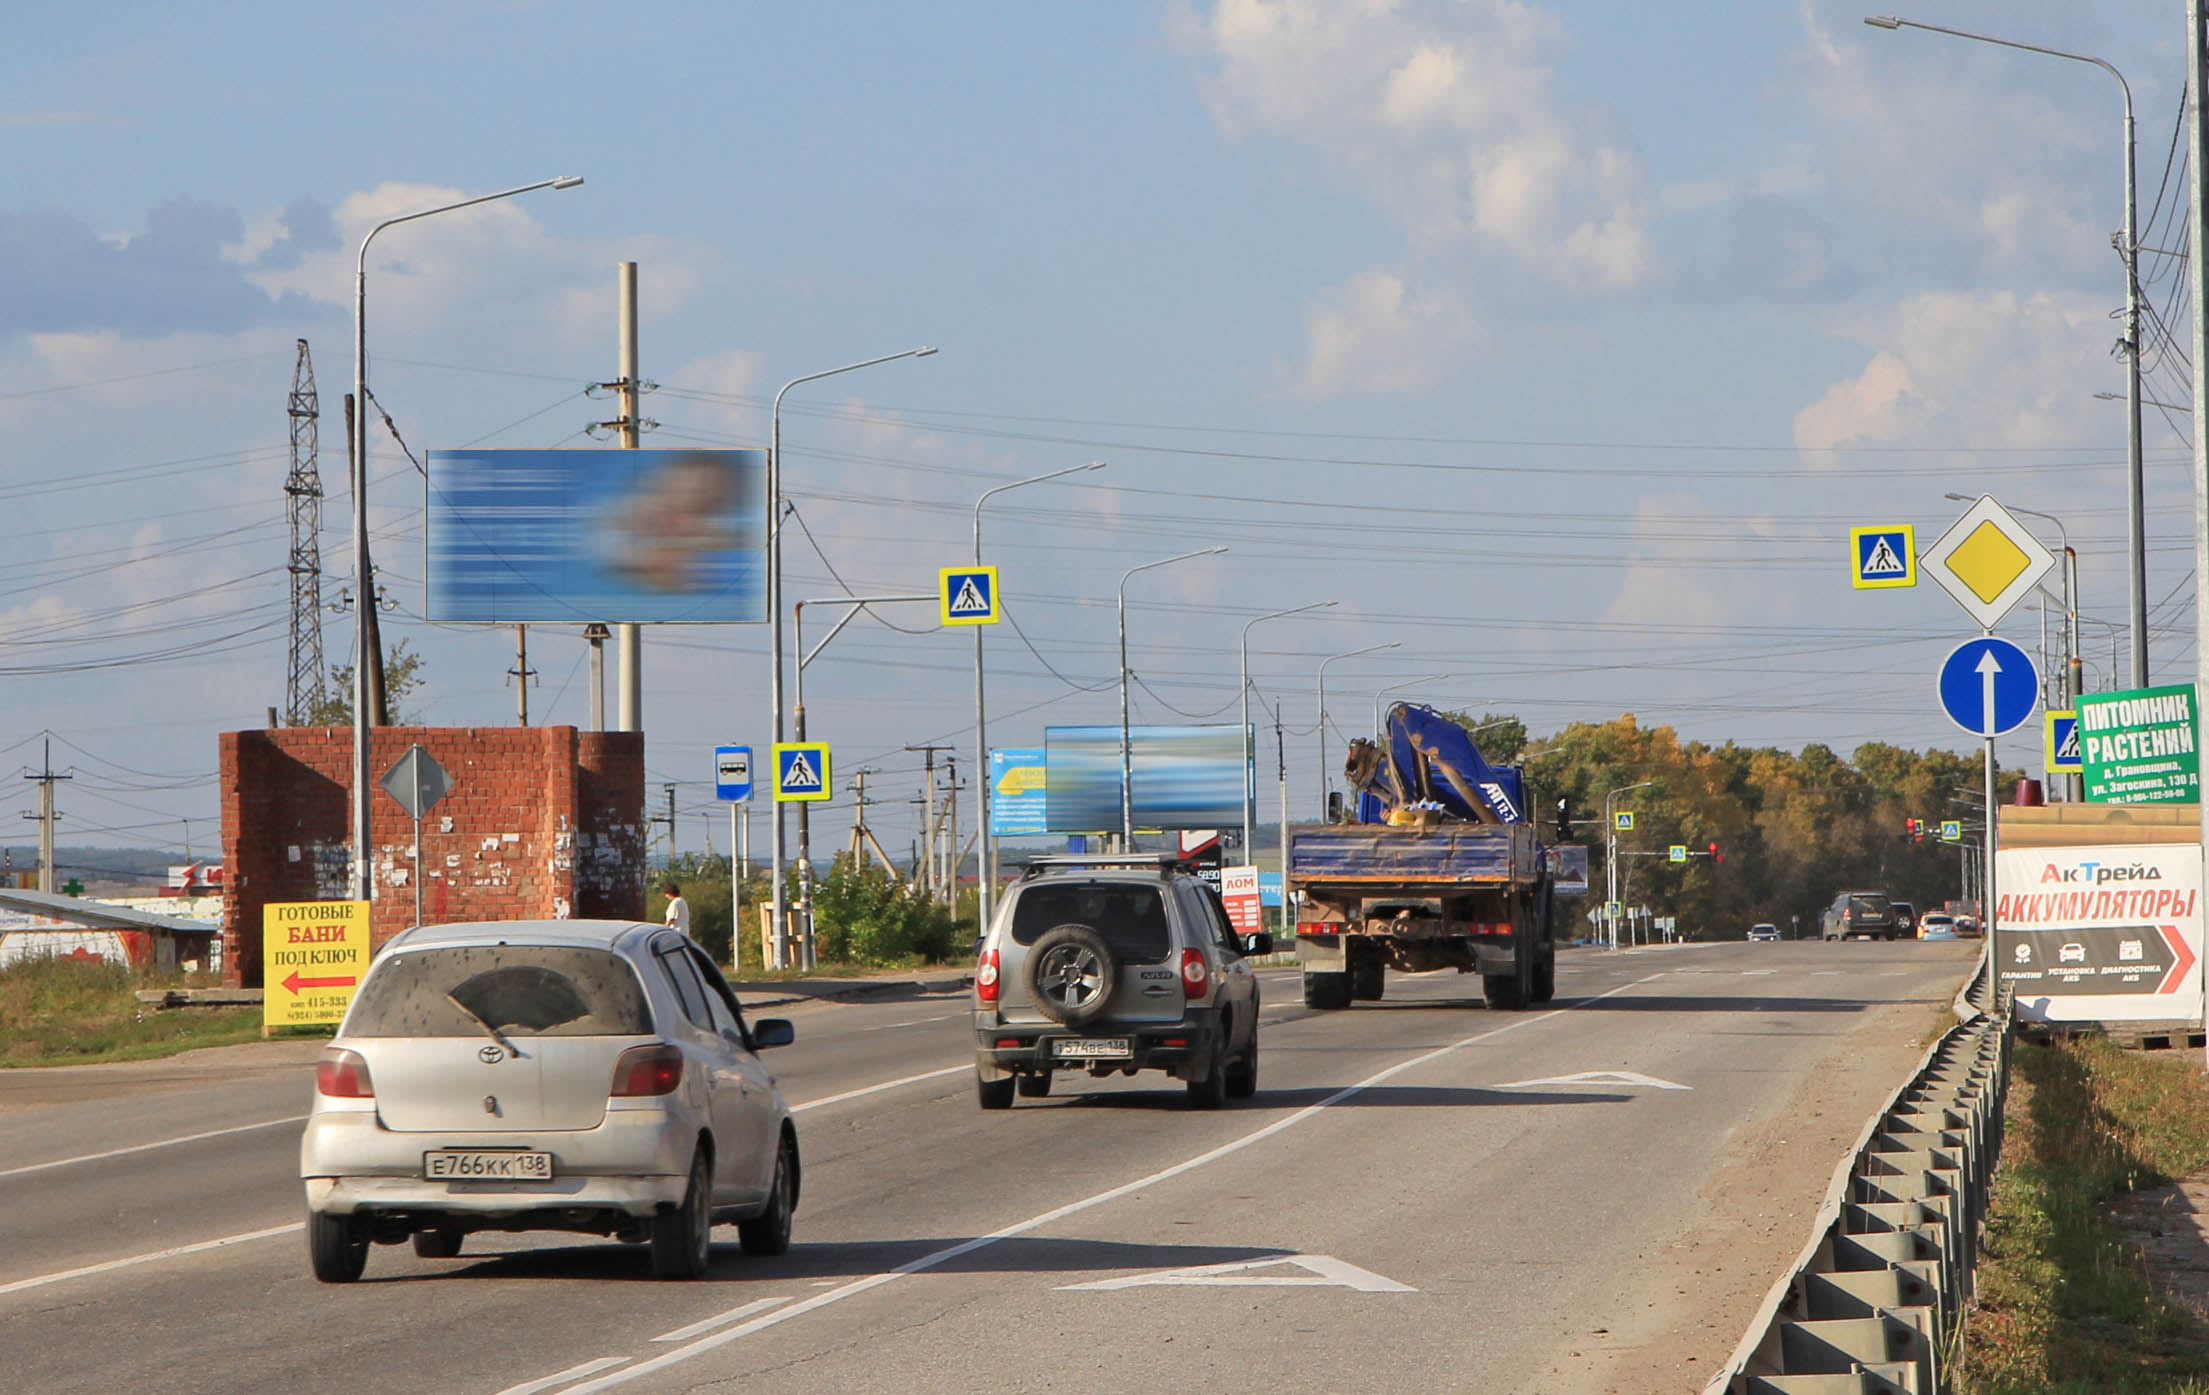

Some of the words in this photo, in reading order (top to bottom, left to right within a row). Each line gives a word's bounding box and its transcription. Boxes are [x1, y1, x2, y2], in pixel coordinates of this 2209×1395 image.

[2082, 694, 2190, 731] ПИТОМНИК
[2086, 722, 2194, 764] РАСТЕНИЙ
[2092, 785, 2107, 796] ул.
[2168, 774, 2187, 787] 130
[2041, 862, 2162, 885] АкТрейд
[1226, 878, 1254, 889] ЛОМ
[278, 905, 354, 921] ГОТОВЫЕ
[1996, 889, 2197, 923] АККУМУЛЯТОРЫ
[288, 925, 346, 943] БАНИ
[275, 951, 307, 968] ПОД
[310, 949, 357, 964] КЛЮЧ
[2001, 971, 2042, 980] ГАРАНТИЯ
[2048, 967, 2096, 976] УСТАНОВКА
[2101, 965, 2161, 975] ДИАГНОСТИКА
[2122, 974, 2140, 982] АКБ
[2063, 975, 2080, 983] АКБ
[515, 1155, 546, 1171] 138
